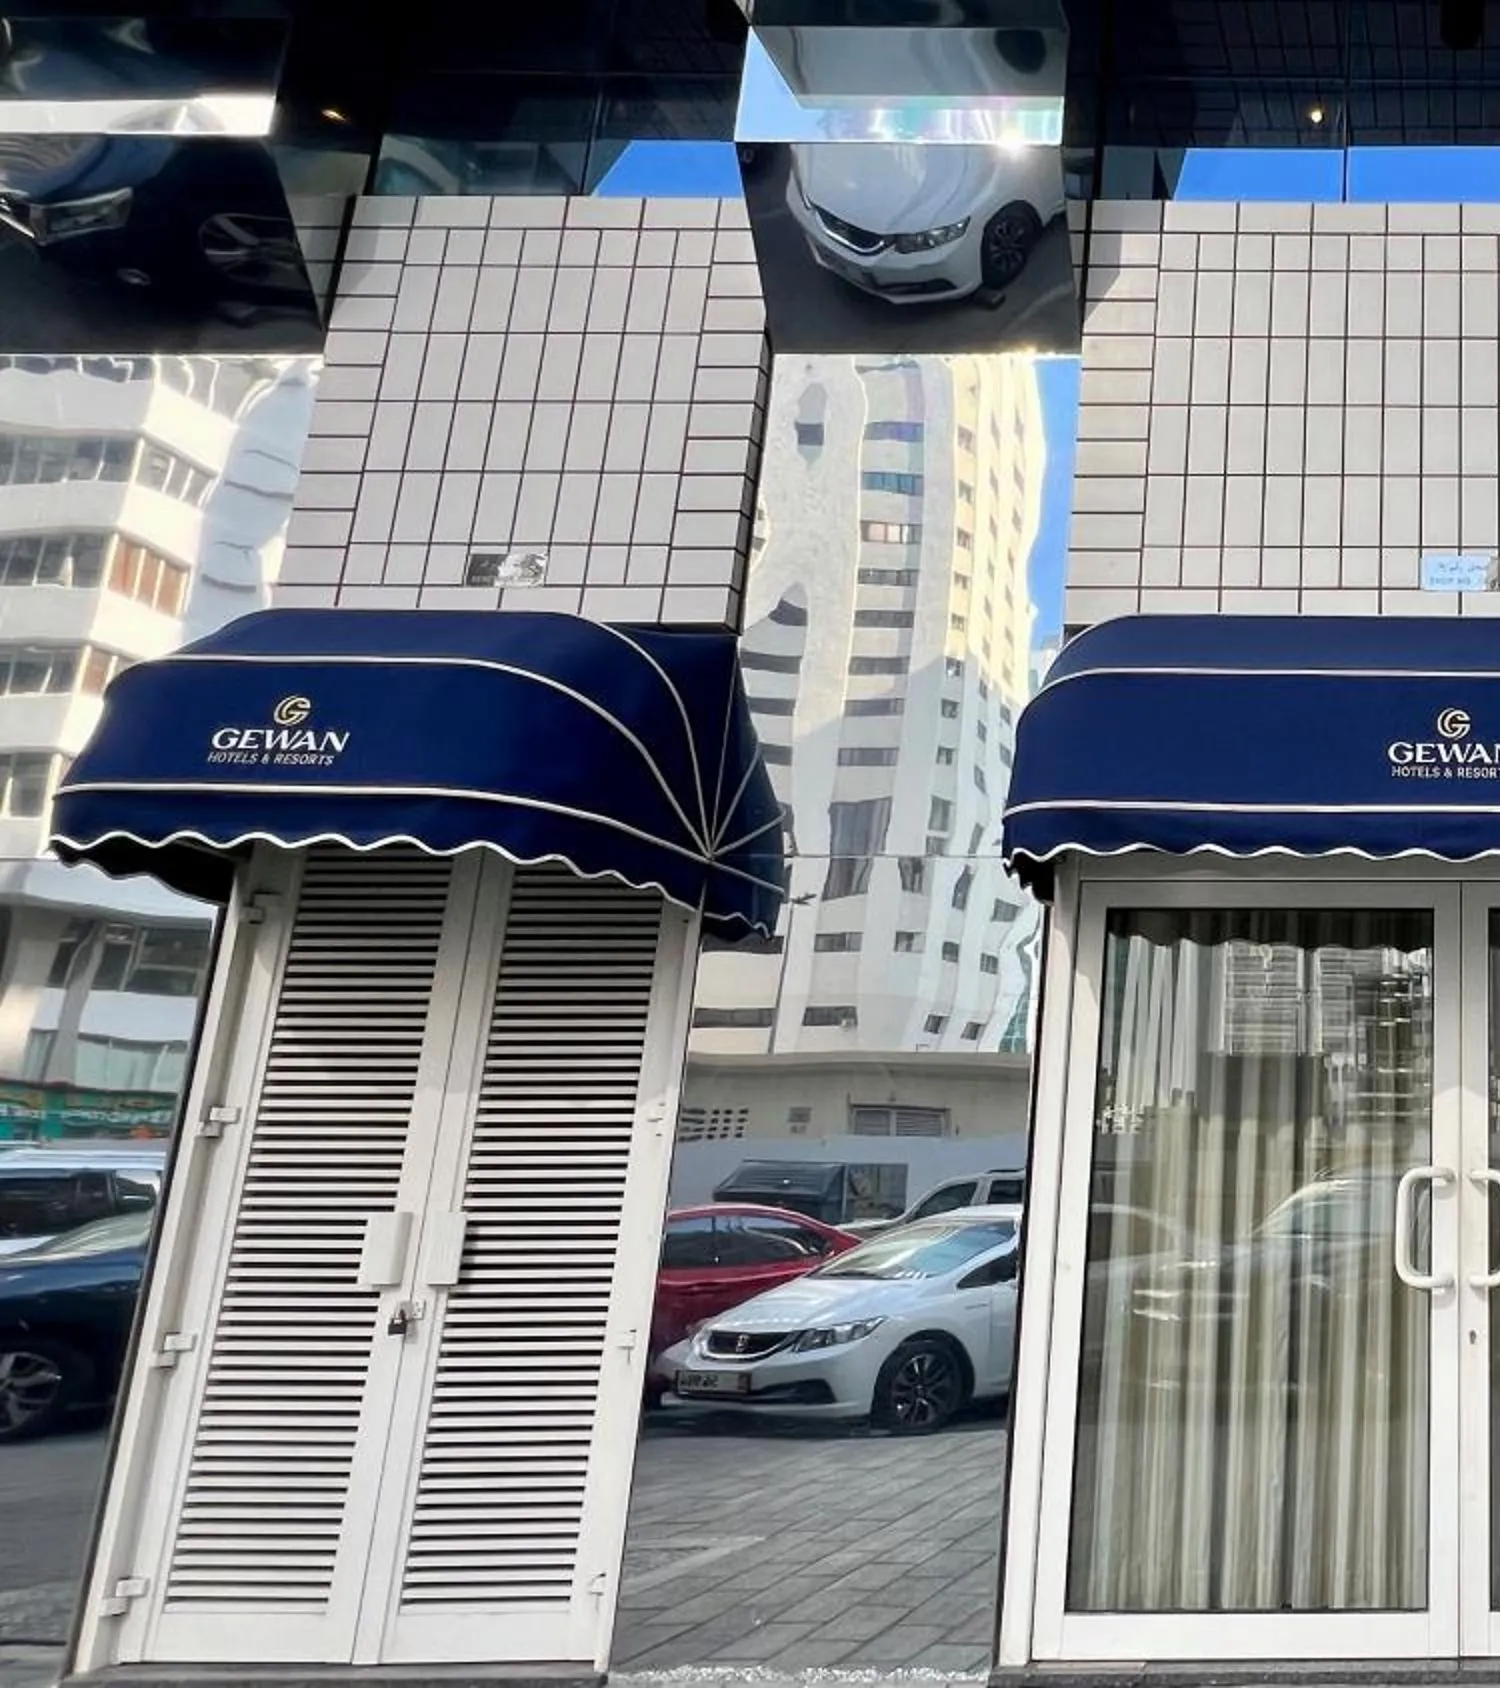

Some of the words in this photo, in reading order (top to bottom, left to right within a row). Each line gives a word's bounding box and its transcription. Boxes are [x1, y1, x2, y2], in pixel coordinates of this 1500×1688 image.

[211, 727, 351, 753] GEWAN
[207, 751, 258, 765] HOTELS
[260, 754, 270, 766] &
[273, 753, 335, 767] RESORTS
[1391, 765, 1441, 779] HOTELS
[1443, 767, 1452, 779] &
